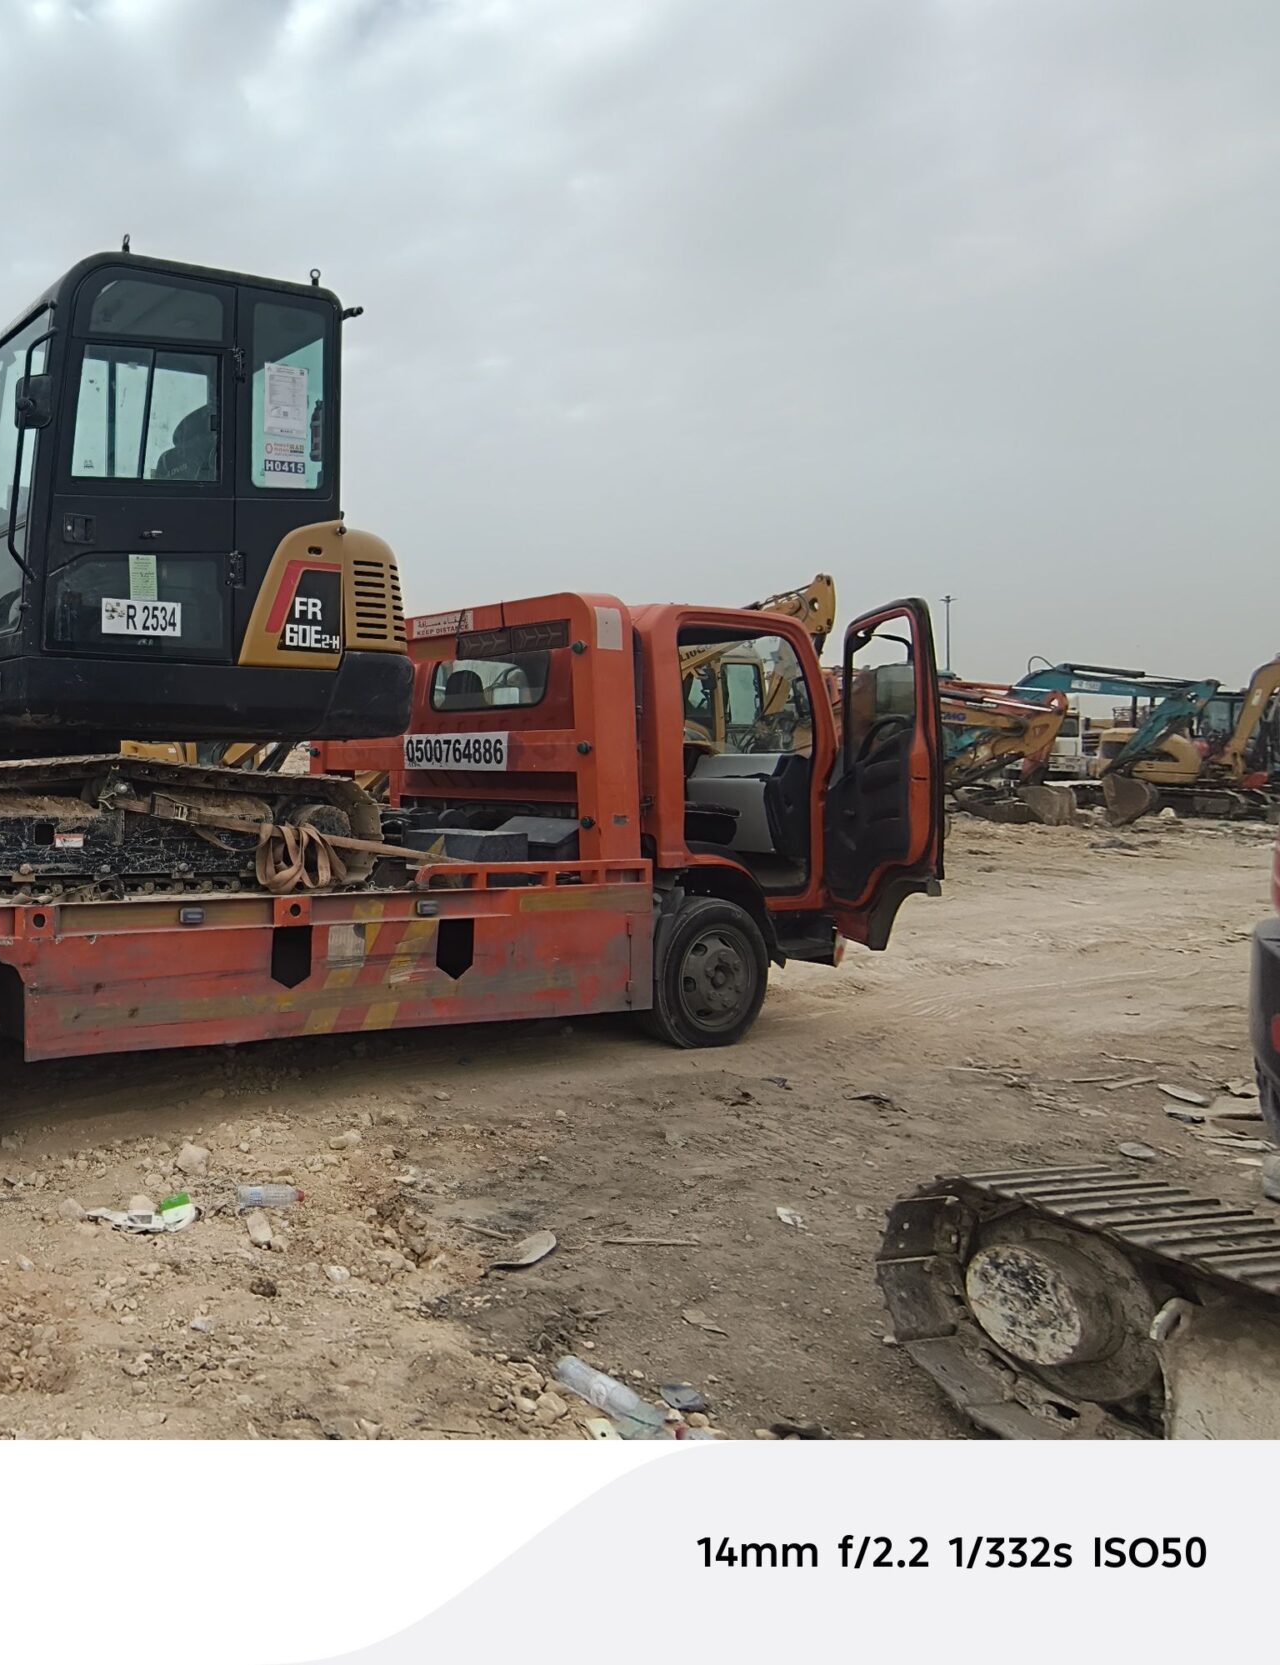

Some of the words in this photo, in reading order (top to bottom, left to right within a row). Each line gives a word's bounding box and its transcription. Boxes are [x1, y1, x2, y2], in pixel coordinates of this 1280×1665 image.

[265, 460, 304, 474] H0415
[126, 604, 138, 631] R
[141, 605, 177, 632] 2534
[294, 596, 323, 621] FR
[417, 628, 435, 636] KEEP
[406, 738, 504, 765] 0500764886
